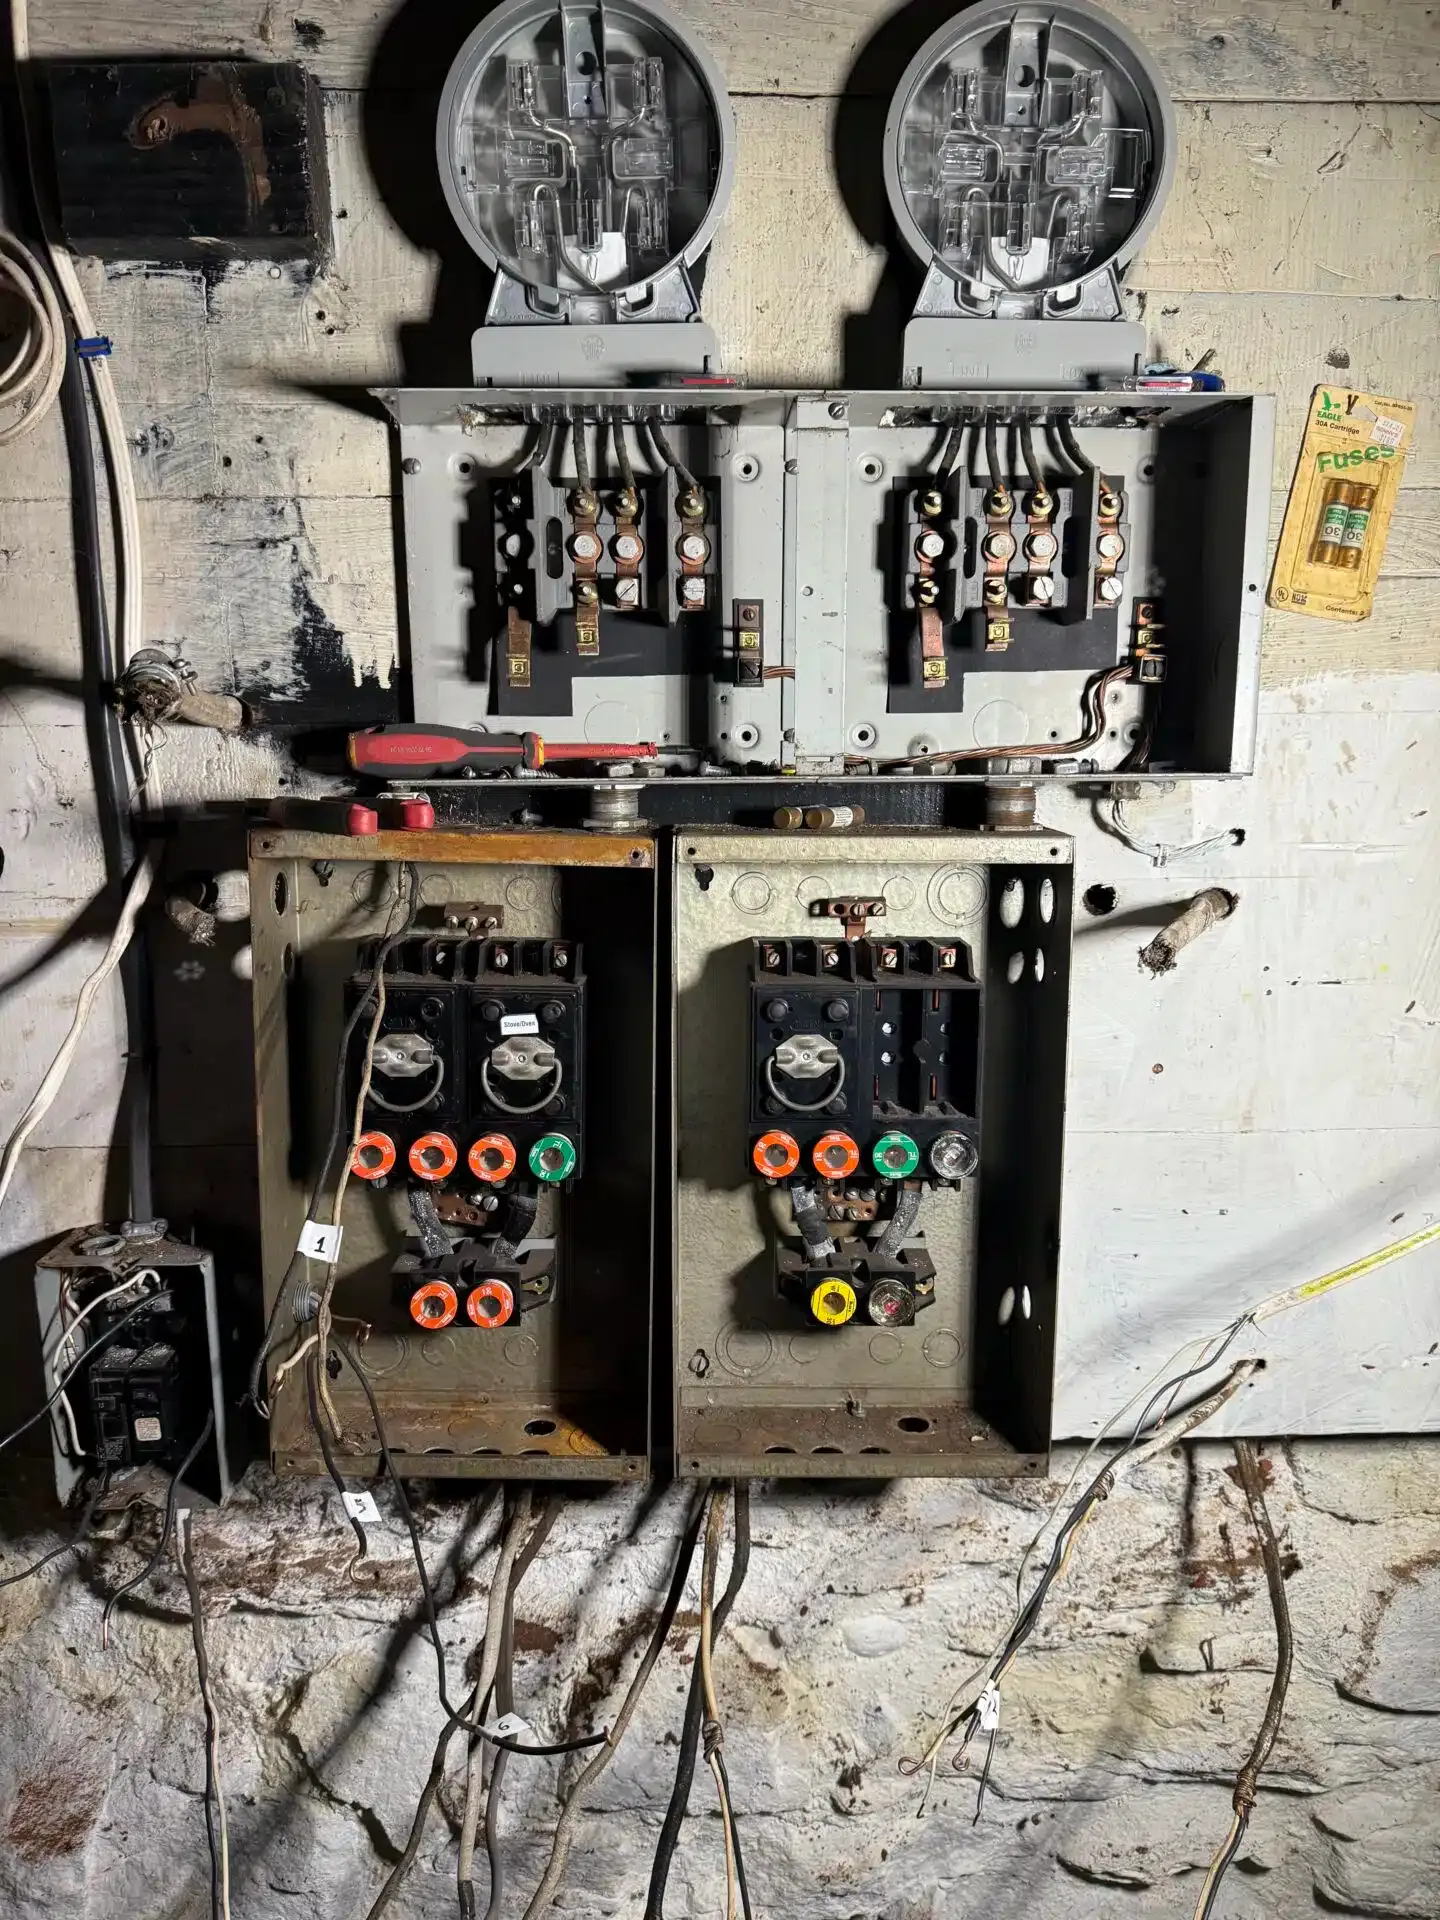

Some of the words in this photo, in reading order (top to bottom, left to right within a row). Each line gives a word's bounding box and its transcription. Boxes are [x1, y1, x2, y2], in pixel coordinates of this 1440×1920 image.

[1316, 410, 1342, 422] EAGLE
[1315, 419, 1328, 428] 30A
[1329, 422, 1360, 435] Cartridge
[1317, 445, 1395, 473] Fuses
[1324, 526, 1341, 536] 30
[1325, 605, 1358, 615] Contents:
[503, 1020, 536, 1028] Stove/Oven
[552, 1139, 560, 1148] TL
[313, 1236, 326, 1254] 1
[498, 1721, 510, 1731] 6
